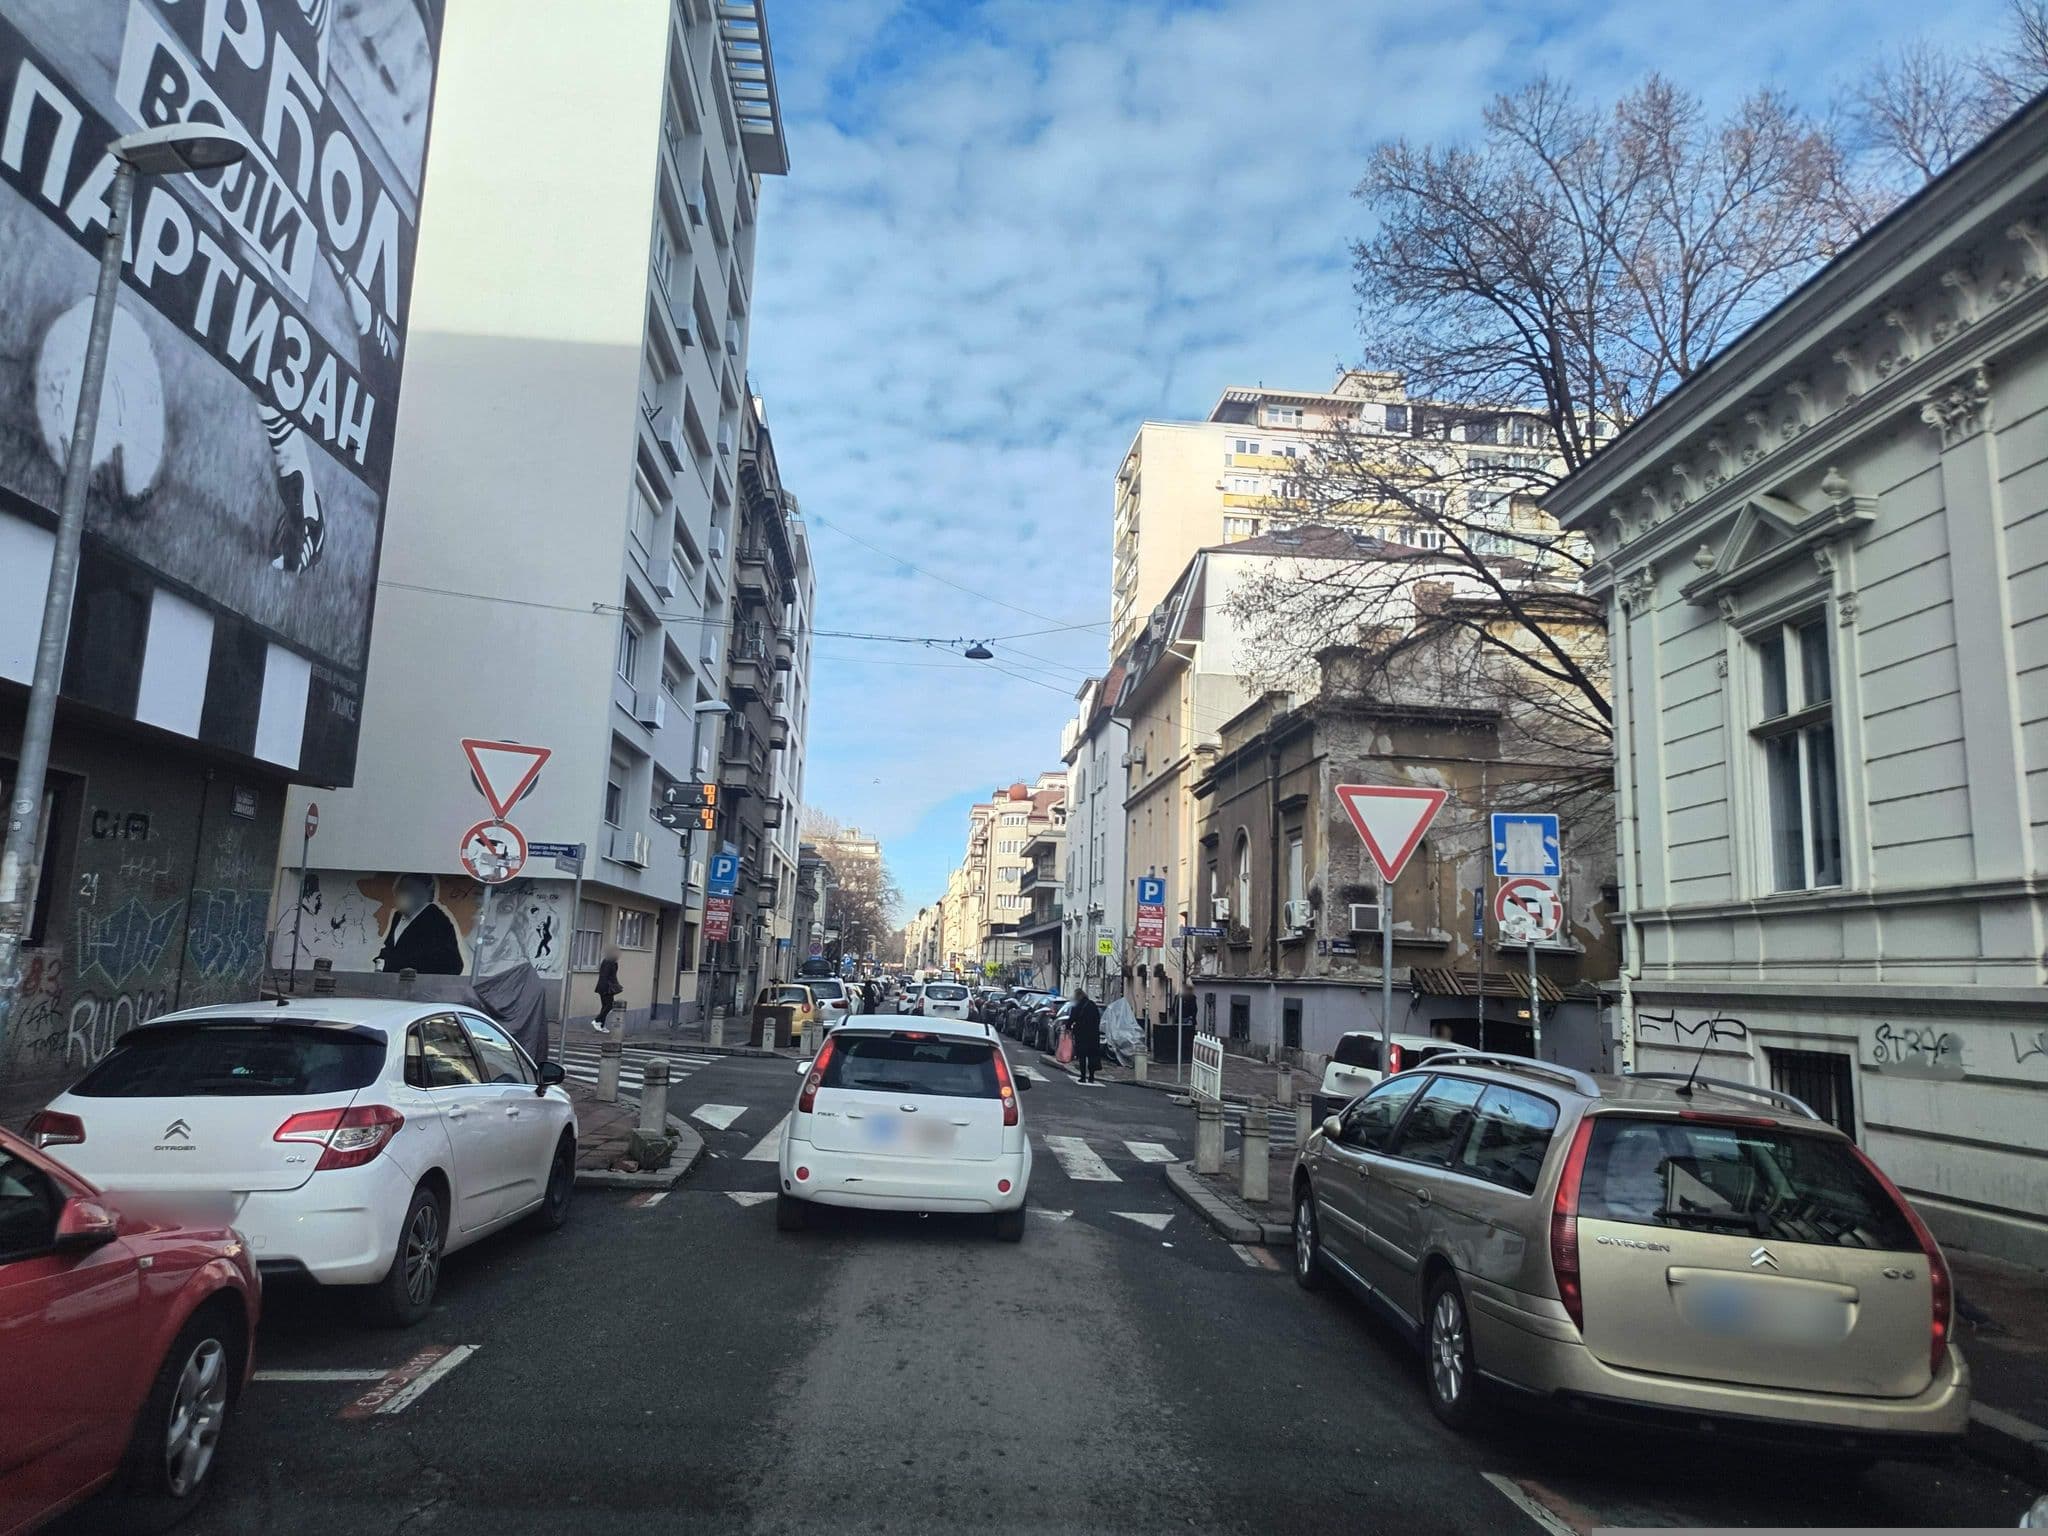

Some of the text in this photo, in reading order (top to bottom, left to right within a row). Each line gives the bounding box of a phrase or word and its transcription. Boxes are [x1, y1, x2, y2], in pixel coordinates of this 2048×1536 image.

[1, 57, 375, 466] ПАРТИЗАН
[716, 859, 731, 878] P
[1144, 881, 1159, 901] P
